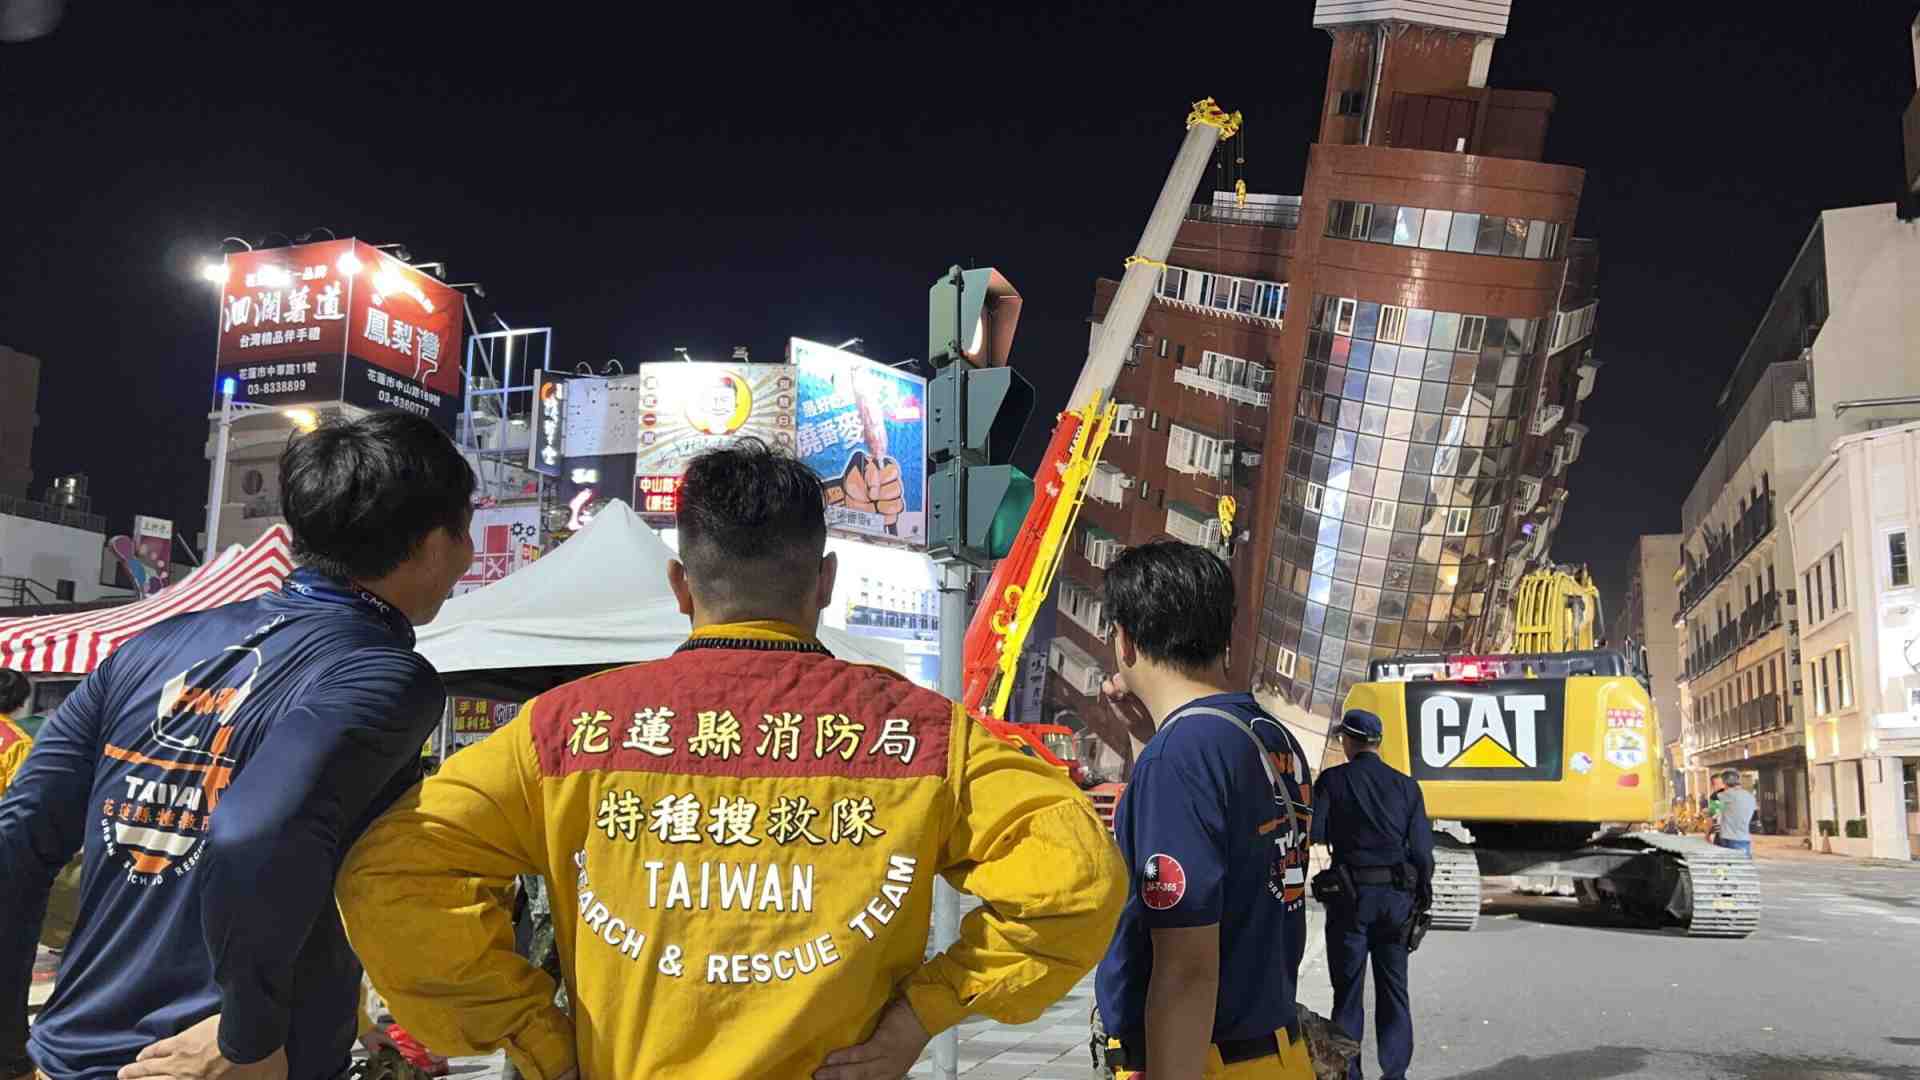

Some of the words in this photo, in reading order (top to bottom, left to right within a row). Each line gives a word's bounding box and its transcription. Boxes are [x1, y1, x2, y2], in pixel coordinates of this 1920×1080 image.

[567, 706, 919, 764] 花蓮縣消防局
[1420, 694, 1547, 768] CAT
[596, 790, 886, 846] 特種搜救隊
[643, 861, 815, 912] TAIWAN
[657, 944, 684, 977] &
[706, 933, 841, 984] RESCUE
[849, 855, 917, 941] TEAM
